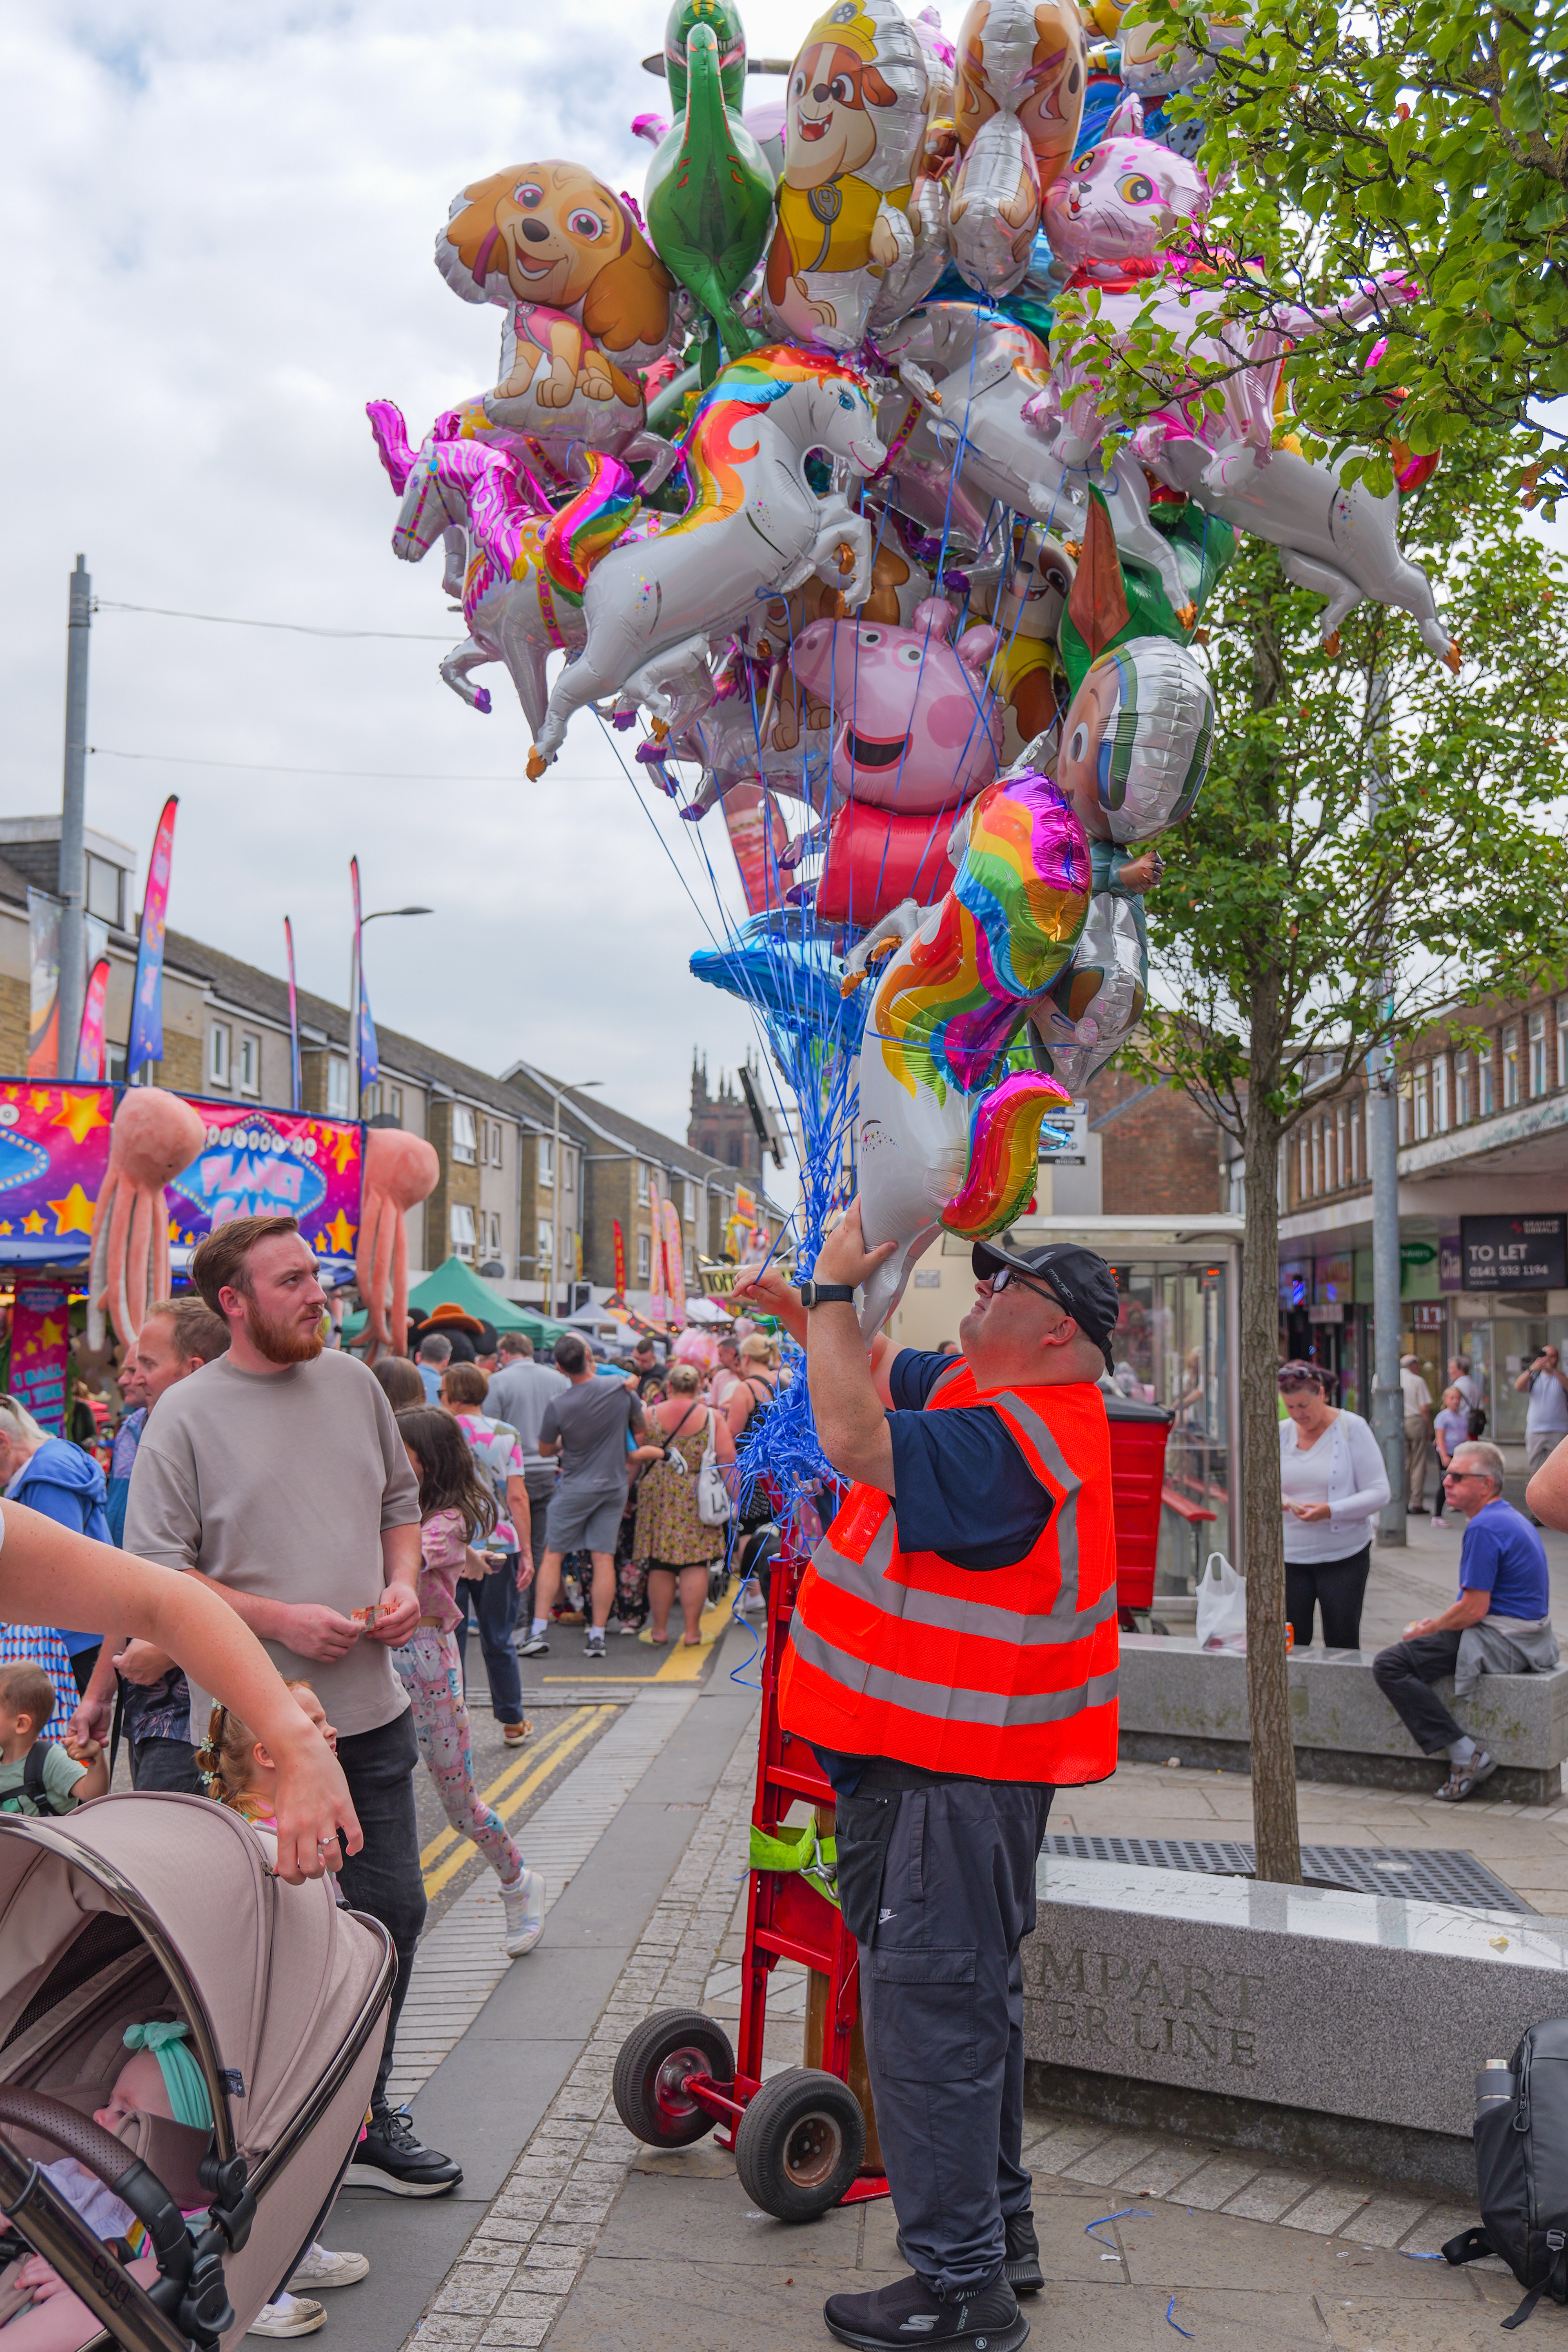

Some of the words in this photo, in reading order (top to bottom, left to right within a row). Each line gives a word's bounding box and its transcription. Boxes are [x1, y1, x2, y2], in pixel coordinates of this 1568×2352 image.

[201, 1153, 304, 1203] PLANET
[1468, 1245, 1494, 1262] TO
[1499, 1243, 1528, 1261] LET
[1469, 1266, 1497, 1277] 0141
[1059, 1283, 1076, 1302] TECH
[25, 1365, 64, 1385] BALL
[33, 1383, 65, 1404] THE
[1022, 1942, 1264, 2021] MPART
[1023, 1996, 1115, 2047] TER
[1131, 2013, 1257, 2069] LINE
